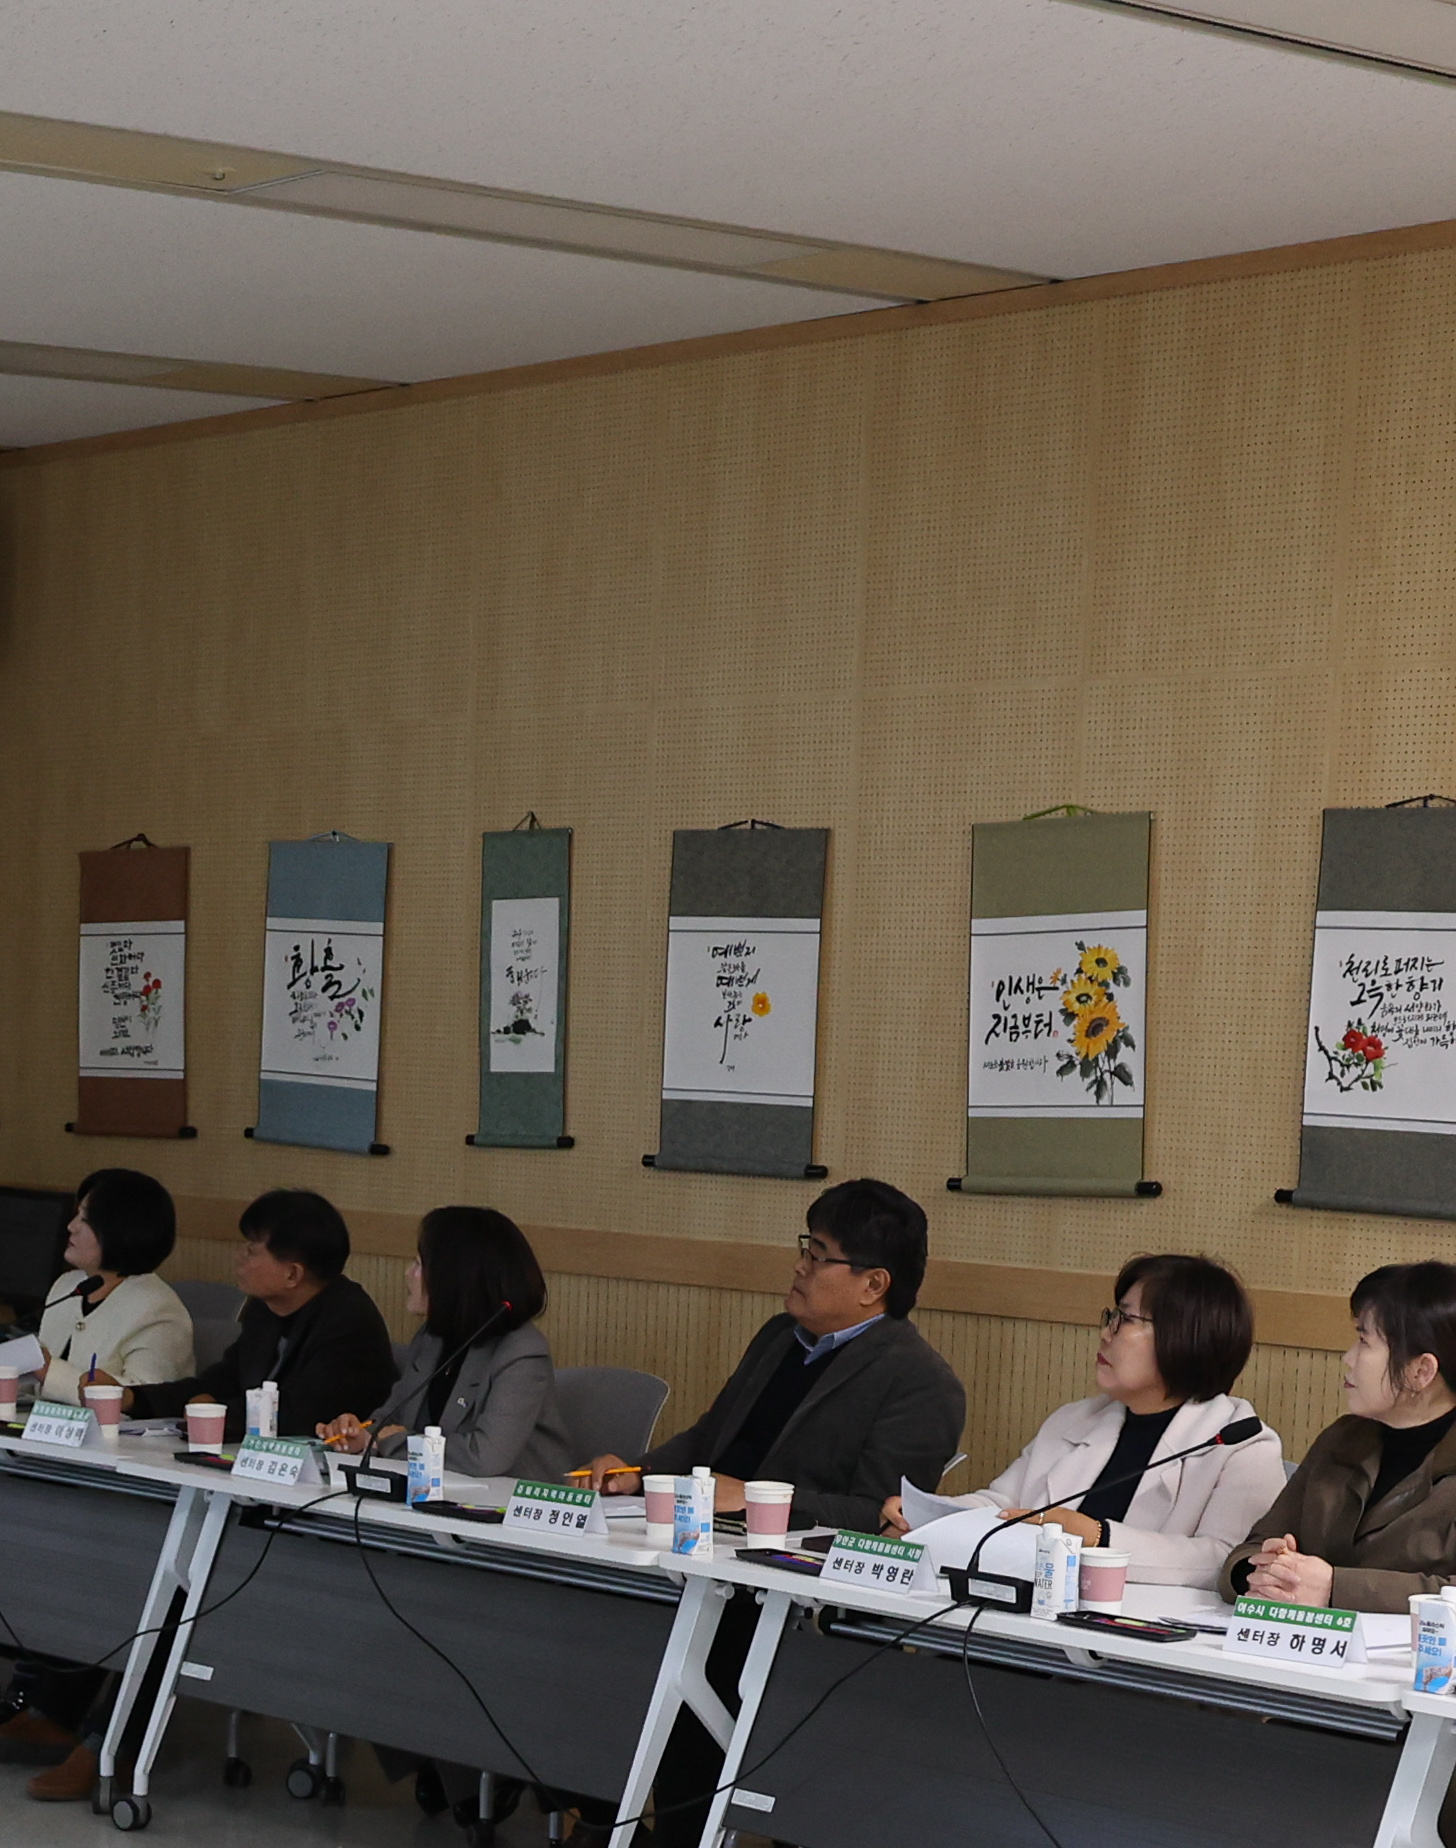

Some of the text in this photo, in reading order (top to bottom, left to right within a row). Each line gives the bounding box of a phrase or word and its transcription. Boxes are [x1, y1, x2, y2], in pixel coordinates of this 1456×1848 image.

[995, 973, 1060, 1011] 인생은
[1405, 975, 1444, 1001] 향기
[984, 1010, 1053, 1045] 지금부터
[239, 1456, 263, 1470] 센터장
[512, 1504, 588, 1531] 센터장 정인열
[831, 1556, 916, 1586] 센터장 박영란
[1237, 1601, 1266, 1617] 여수시
[1270, 1605, 1334, 1627] 다함께돌봄센터
[1236, 1626, 1349, 1659] 센터장 하명서
